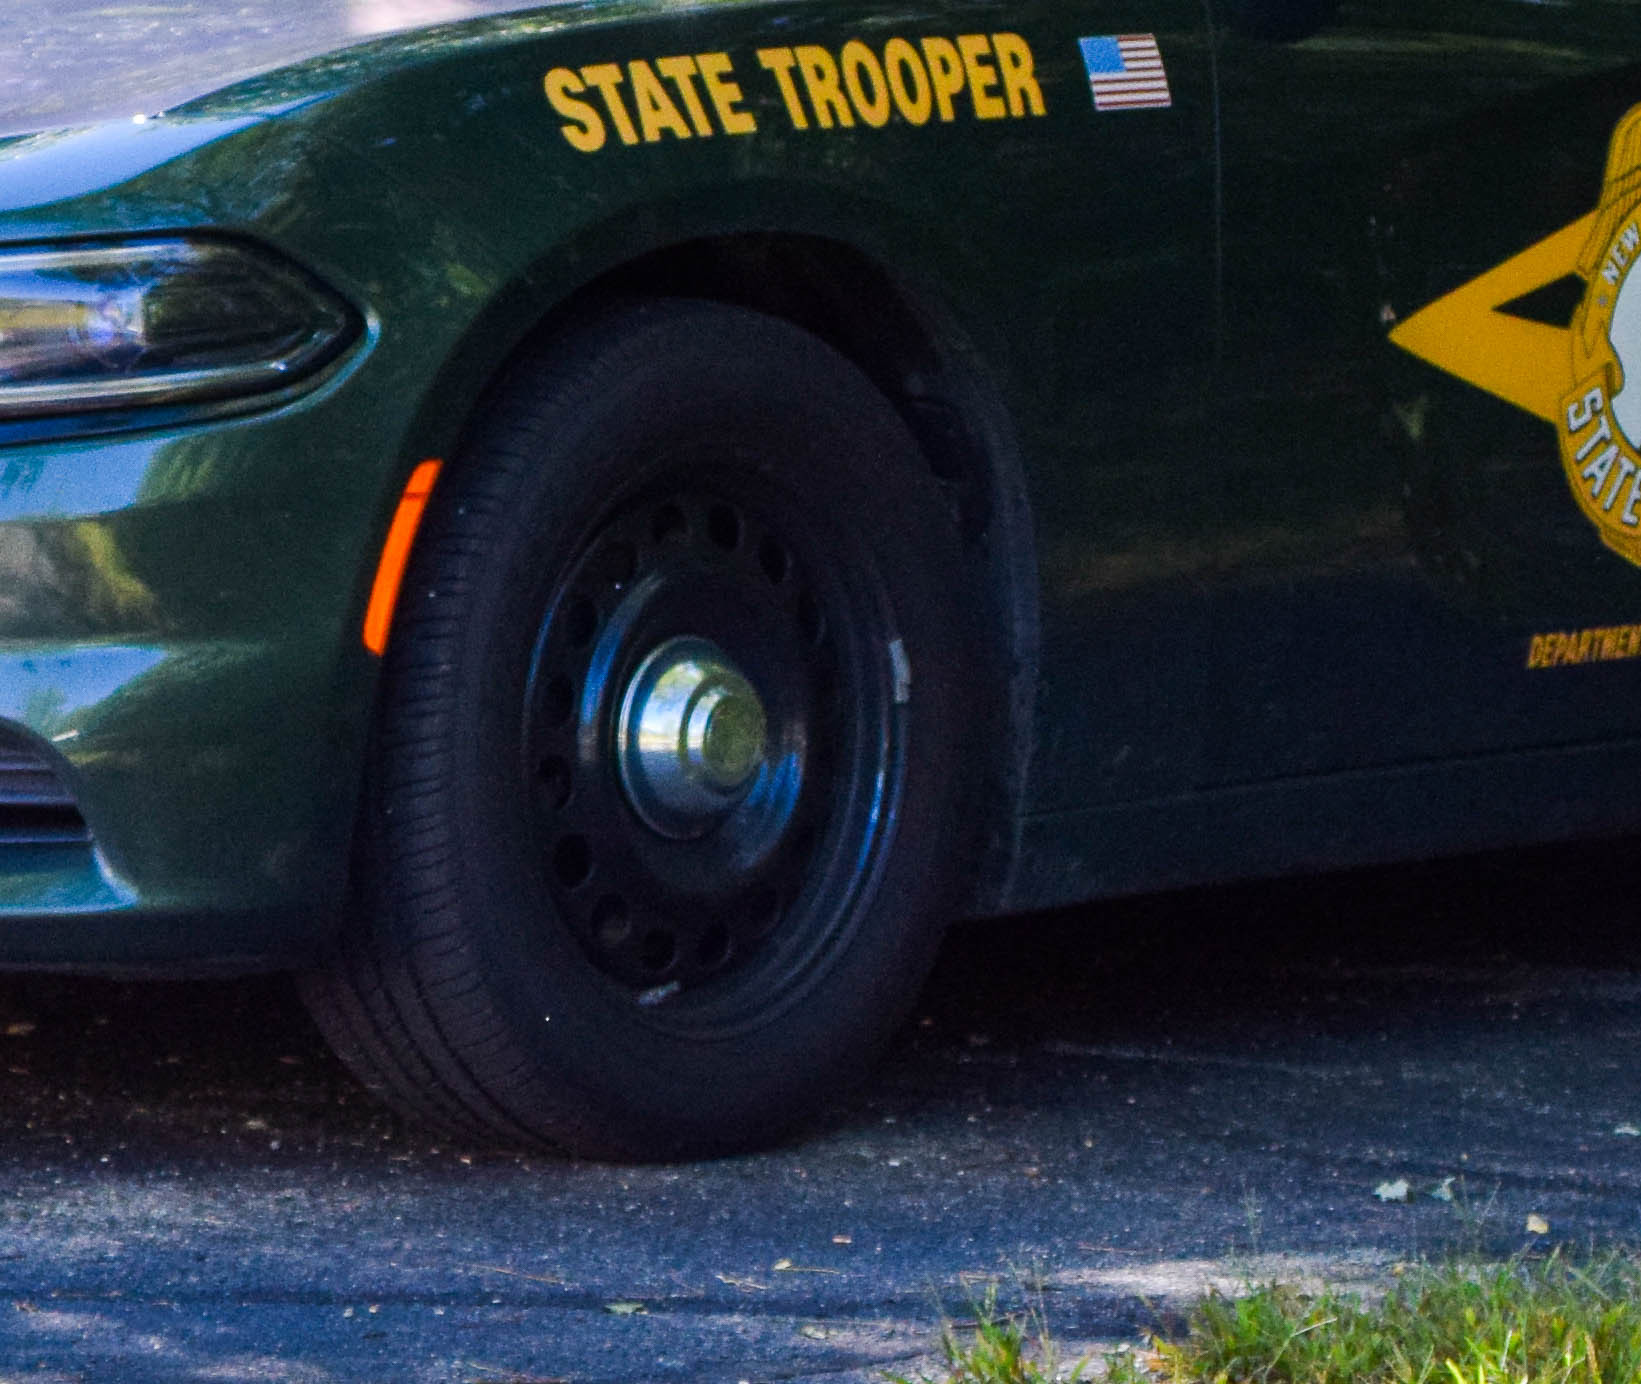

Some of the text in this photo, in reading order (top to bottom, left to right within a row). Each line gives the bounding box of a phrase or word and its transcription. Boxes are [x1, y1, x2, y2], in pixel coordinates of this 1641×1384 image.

[544, 33, 1047, 152] STATE TROOPER
[1601, 220, 1641, 285] NEW
